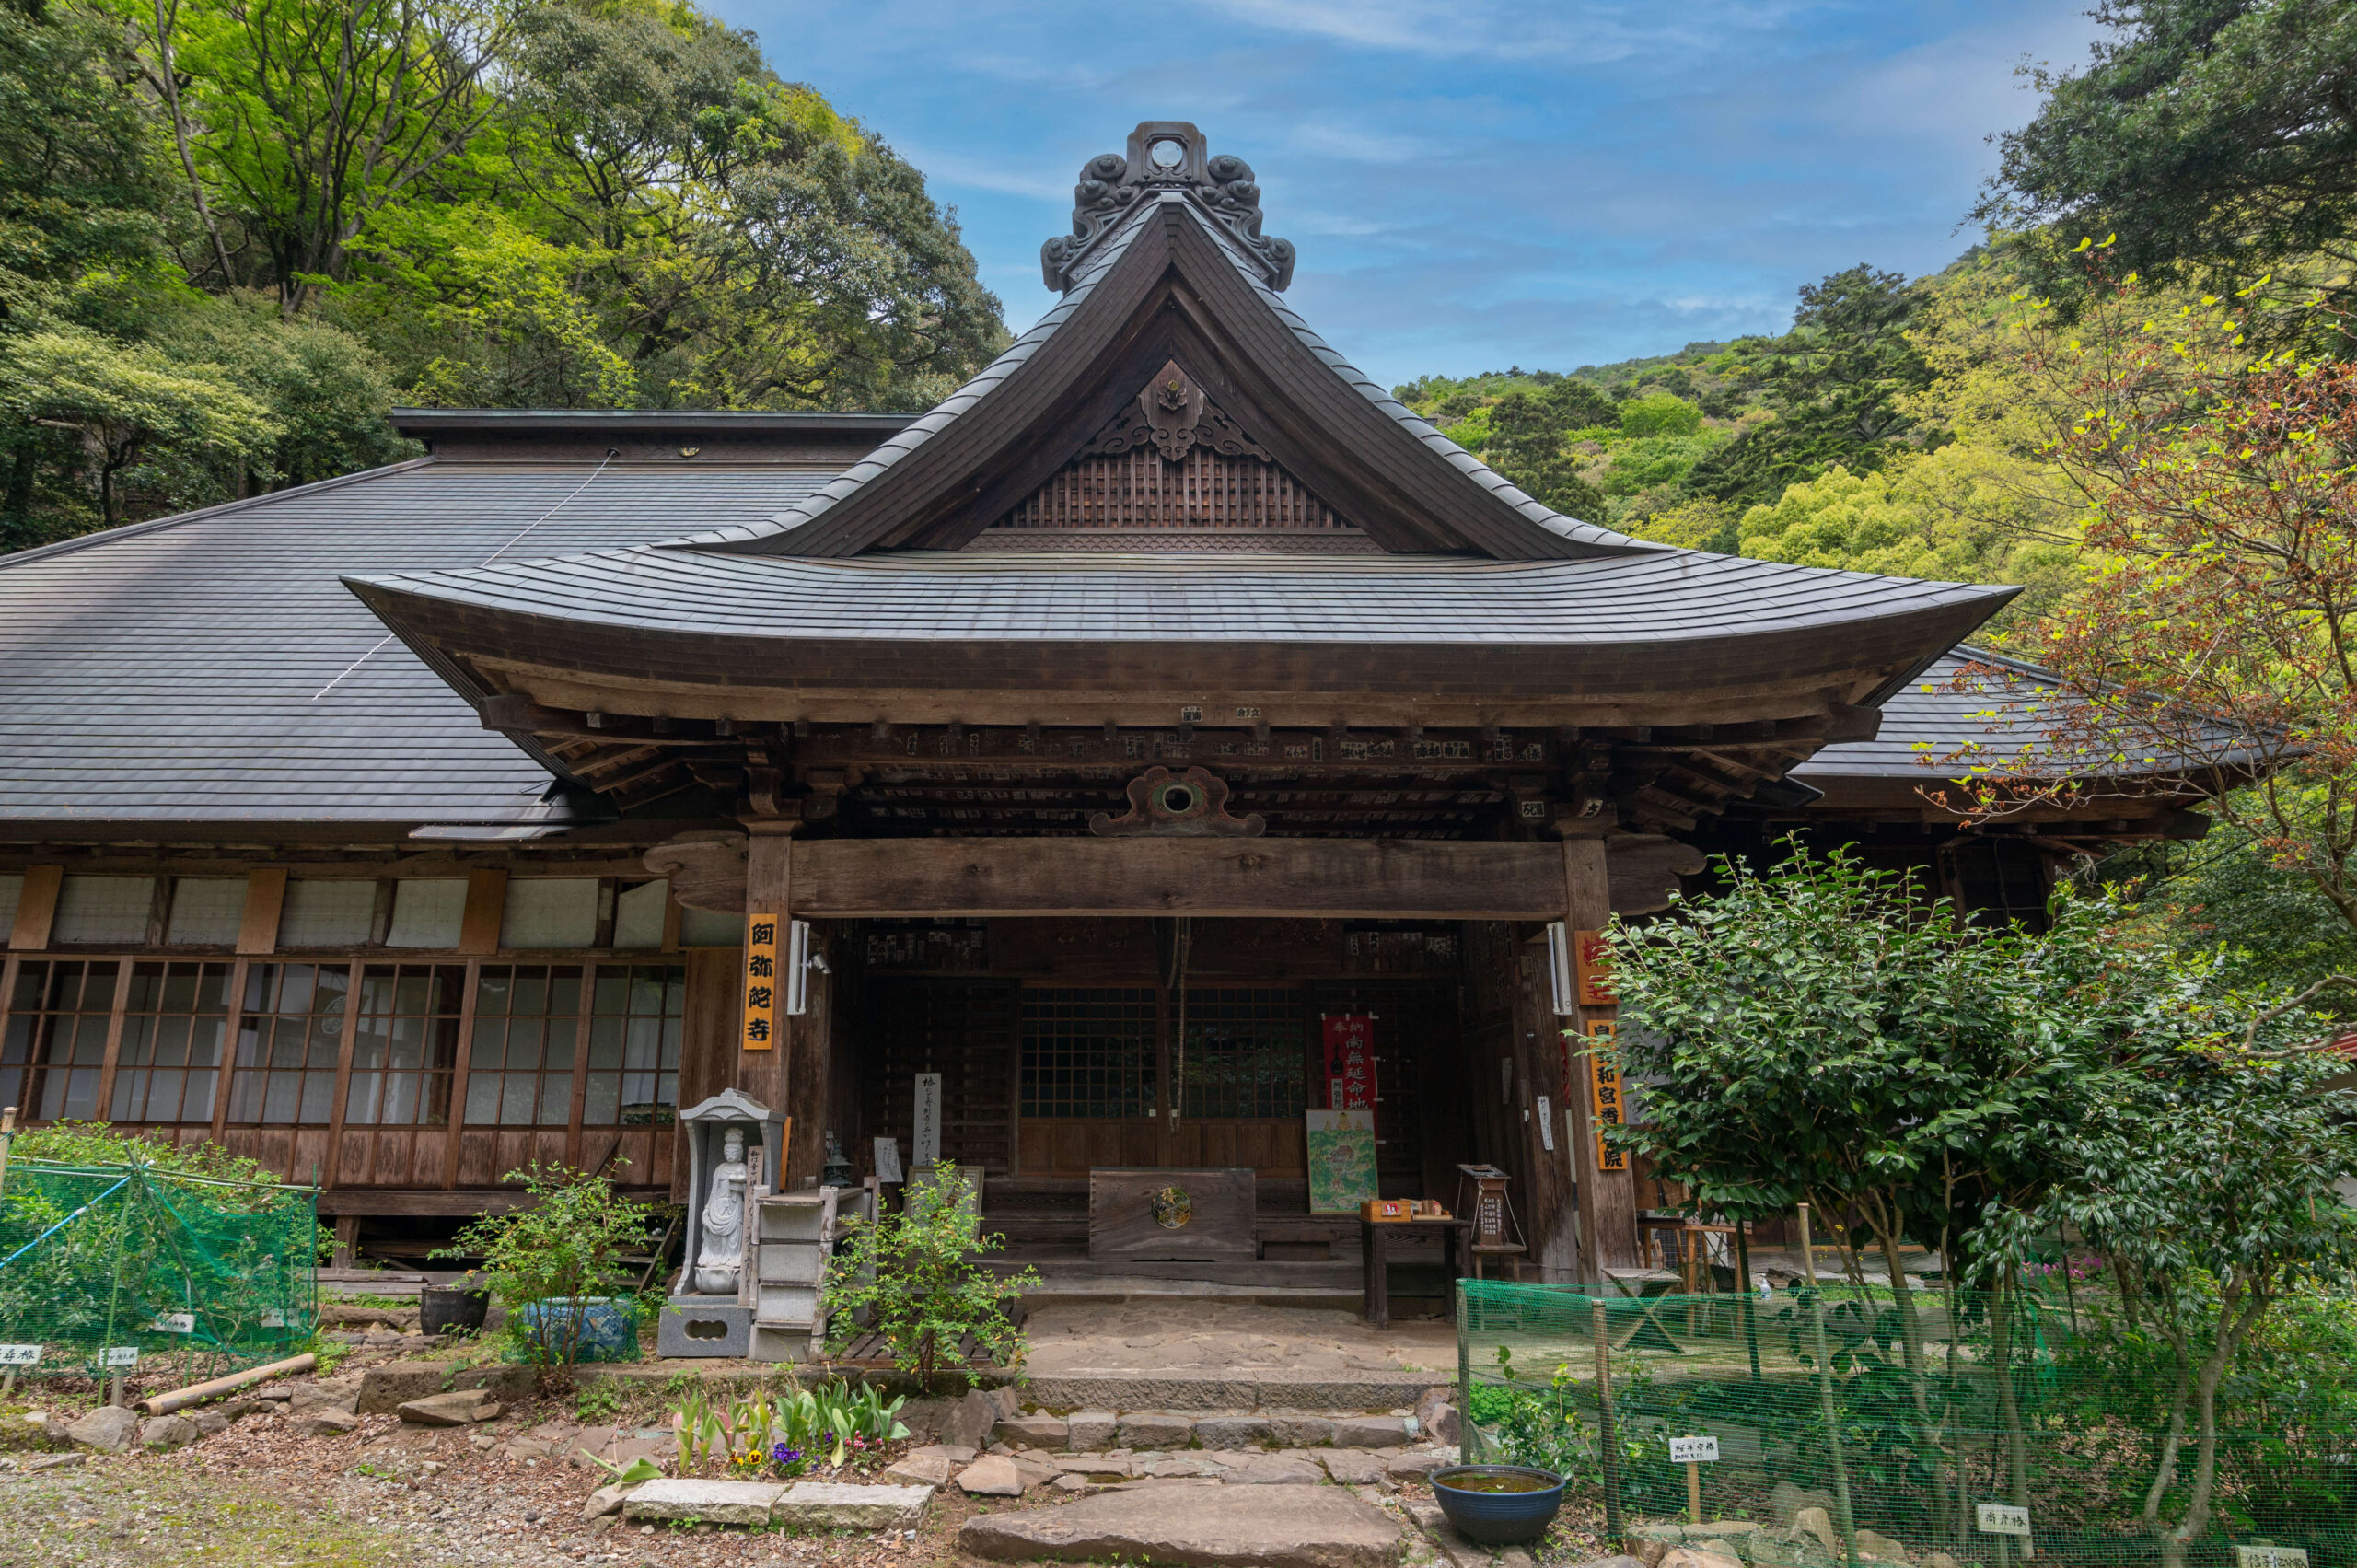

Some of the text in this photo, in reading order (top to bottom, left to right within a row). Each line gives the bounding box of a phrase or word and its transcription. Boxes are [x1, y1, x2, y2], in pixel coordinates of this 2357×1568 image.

[748, 923, 775, 1040] 阿弥陀寺
[1332, 1022, 1364, 1032] 奉納
